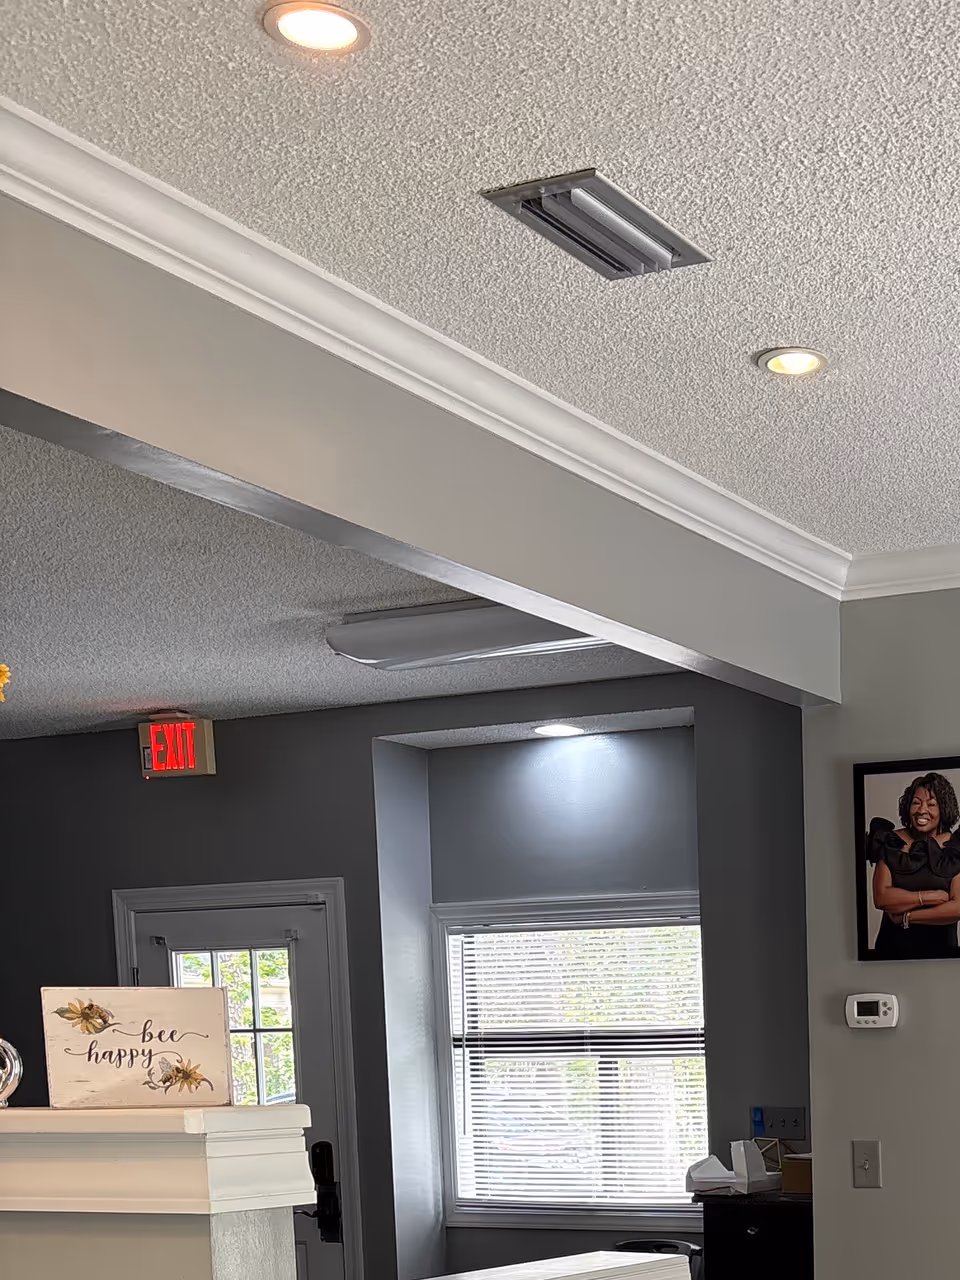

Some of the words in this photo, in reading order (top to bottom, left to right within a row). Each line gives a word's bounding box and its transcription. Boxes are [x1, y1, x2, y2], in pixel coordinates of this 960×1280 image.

[150, 722, 195, 770] EXIT
[112, 1019, 209, 1044] bee
[64, 1040, 183, 1069] happy
